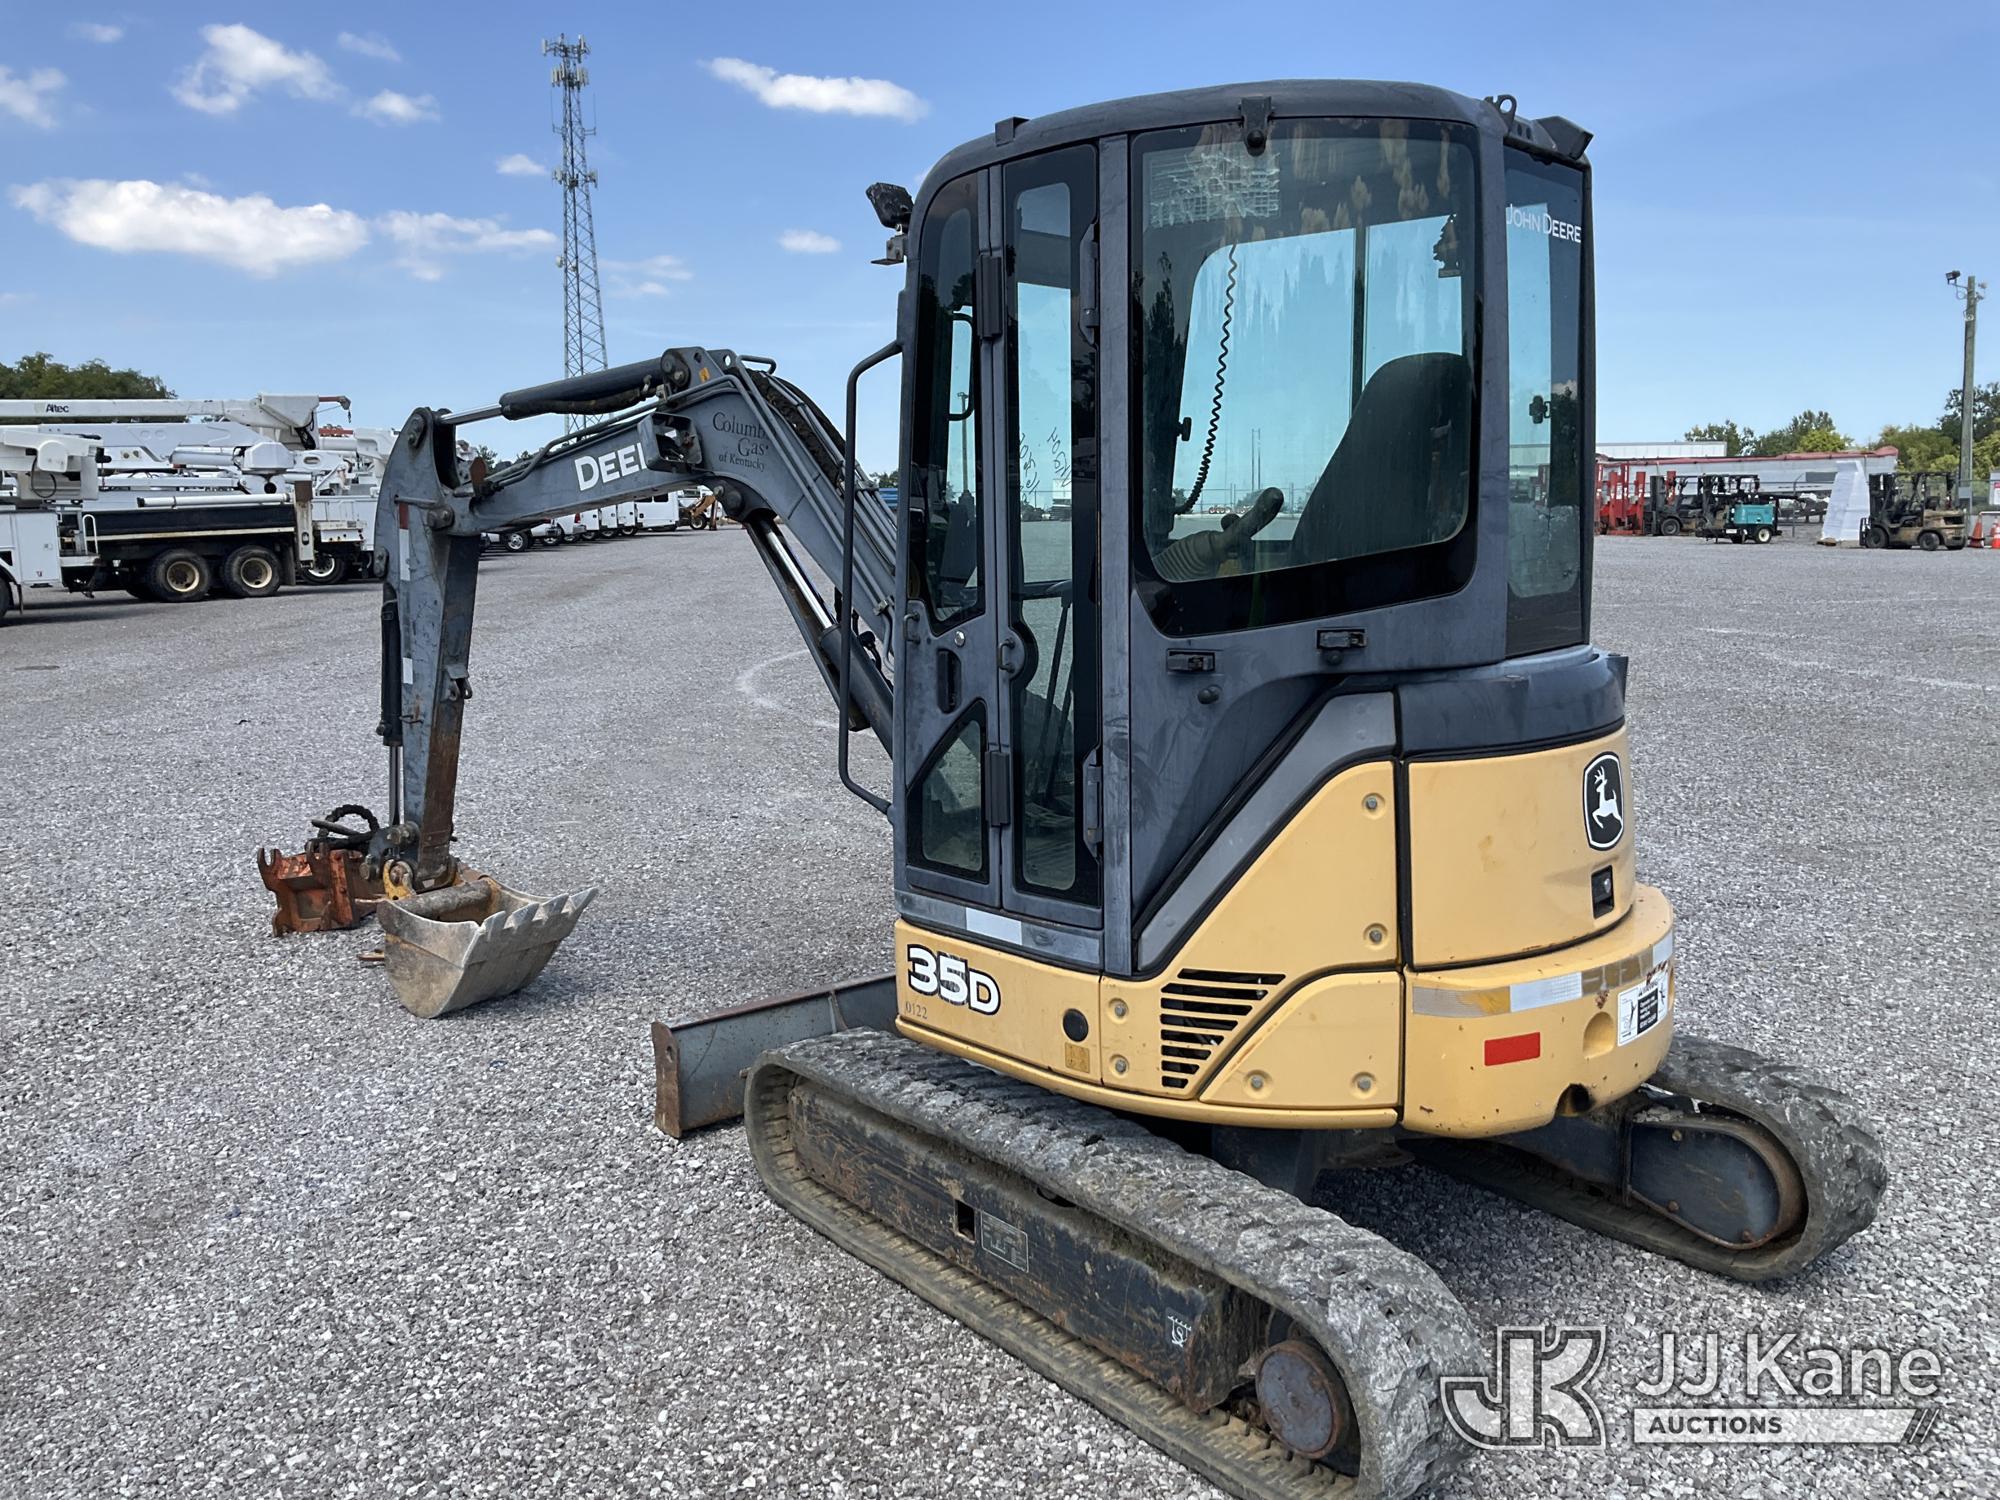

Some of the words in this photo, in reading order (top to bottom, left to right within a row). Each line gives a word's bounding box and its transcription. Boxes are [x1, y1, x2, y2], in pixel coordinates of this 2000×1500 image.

[1506, 203, 1540, 232] JOHN
[1542, 213, 1581, 243] DEERE
[46, 403, 69, 413] Altec
[713, 412, 769, 439] Columb
[719, 452, 727, 463] of
[738, 438, 764, 456] Gas
[907, 944, 1001, 1015] 35D
